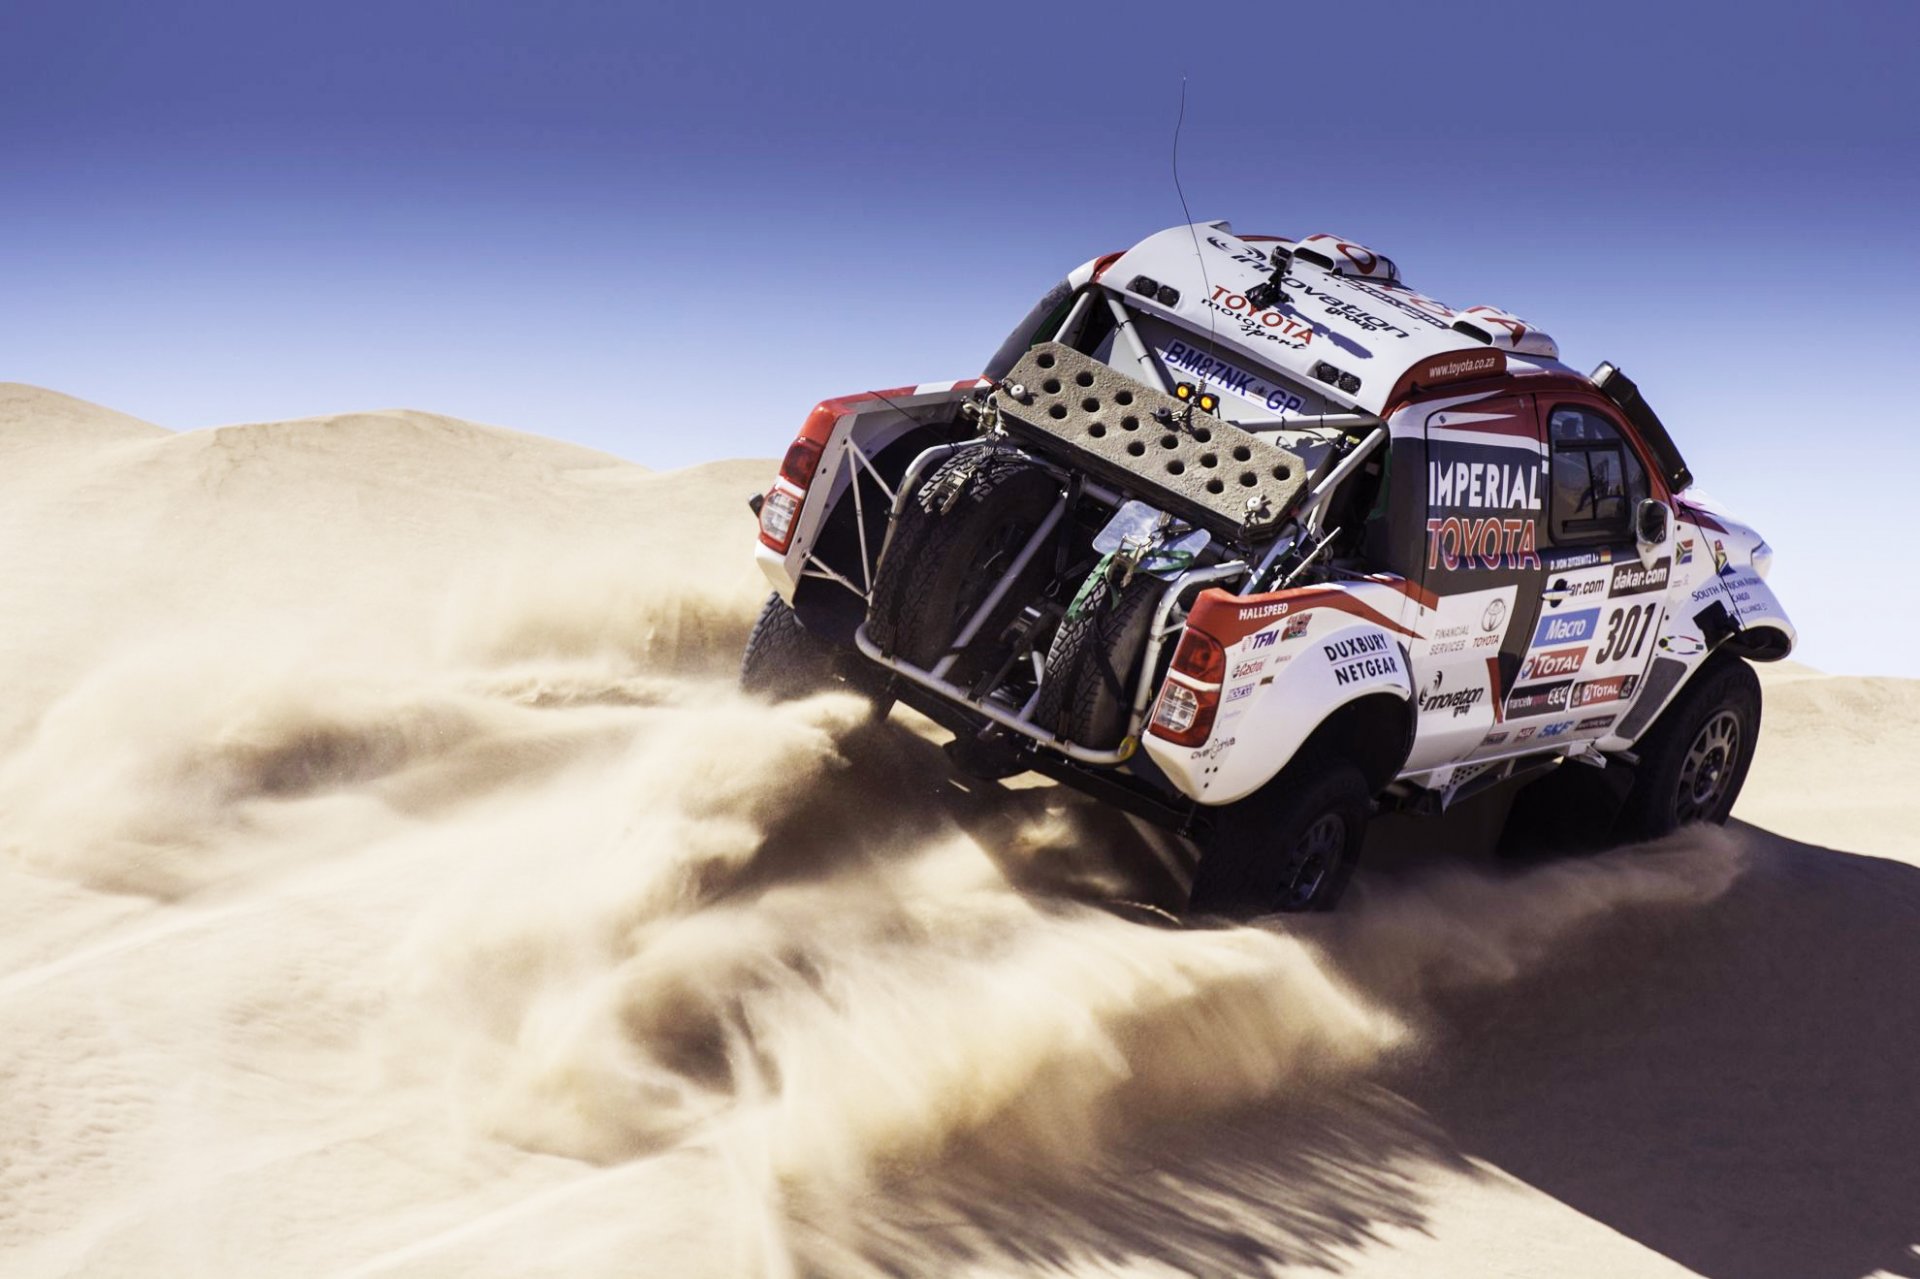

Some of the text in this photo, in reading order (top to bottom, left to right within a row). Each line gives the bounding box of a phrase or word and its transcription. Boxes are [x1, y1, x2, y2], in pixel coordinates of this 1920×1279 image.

[1201, 298, 1265, 329] motor
[1325, 306, 1377, 331] group
[1239, 324, 1306, 349] sport
[1165, 341, 1301, 414] BM87NK GP
[1429, 357, 1495, 378] www.toyota.co.za
[1429, 460, 1541, 510] IMPERIAL
[1427, 517, 1541, 571] TOYOTA
[1613, 567, 1667, 590] dakar.com
[1691, 585, 1719, 601] SOUTH
[1239, 603, 1288, 620] HALLSPEED
[1252, 629, 1279, 650] TFM
[1434, 625, 1470, 639] FINANCIAL
[1545, 618, 1586, 640] Macro
[1596, 603, 1656, 664] 301
[1323, 633, 1388, 661] DUXBURY
[1429, 640, 1466, 655] SERVICES
[1473, 635, 1500, 648] TOYOTA
[1334, 656, 1397, 685] NETGEAR
[1538, 655, 1580, 676] TOTAL
[1592, 684, 1619, 697] TOTAL
[1537, 720, 1575, 739] SKF
